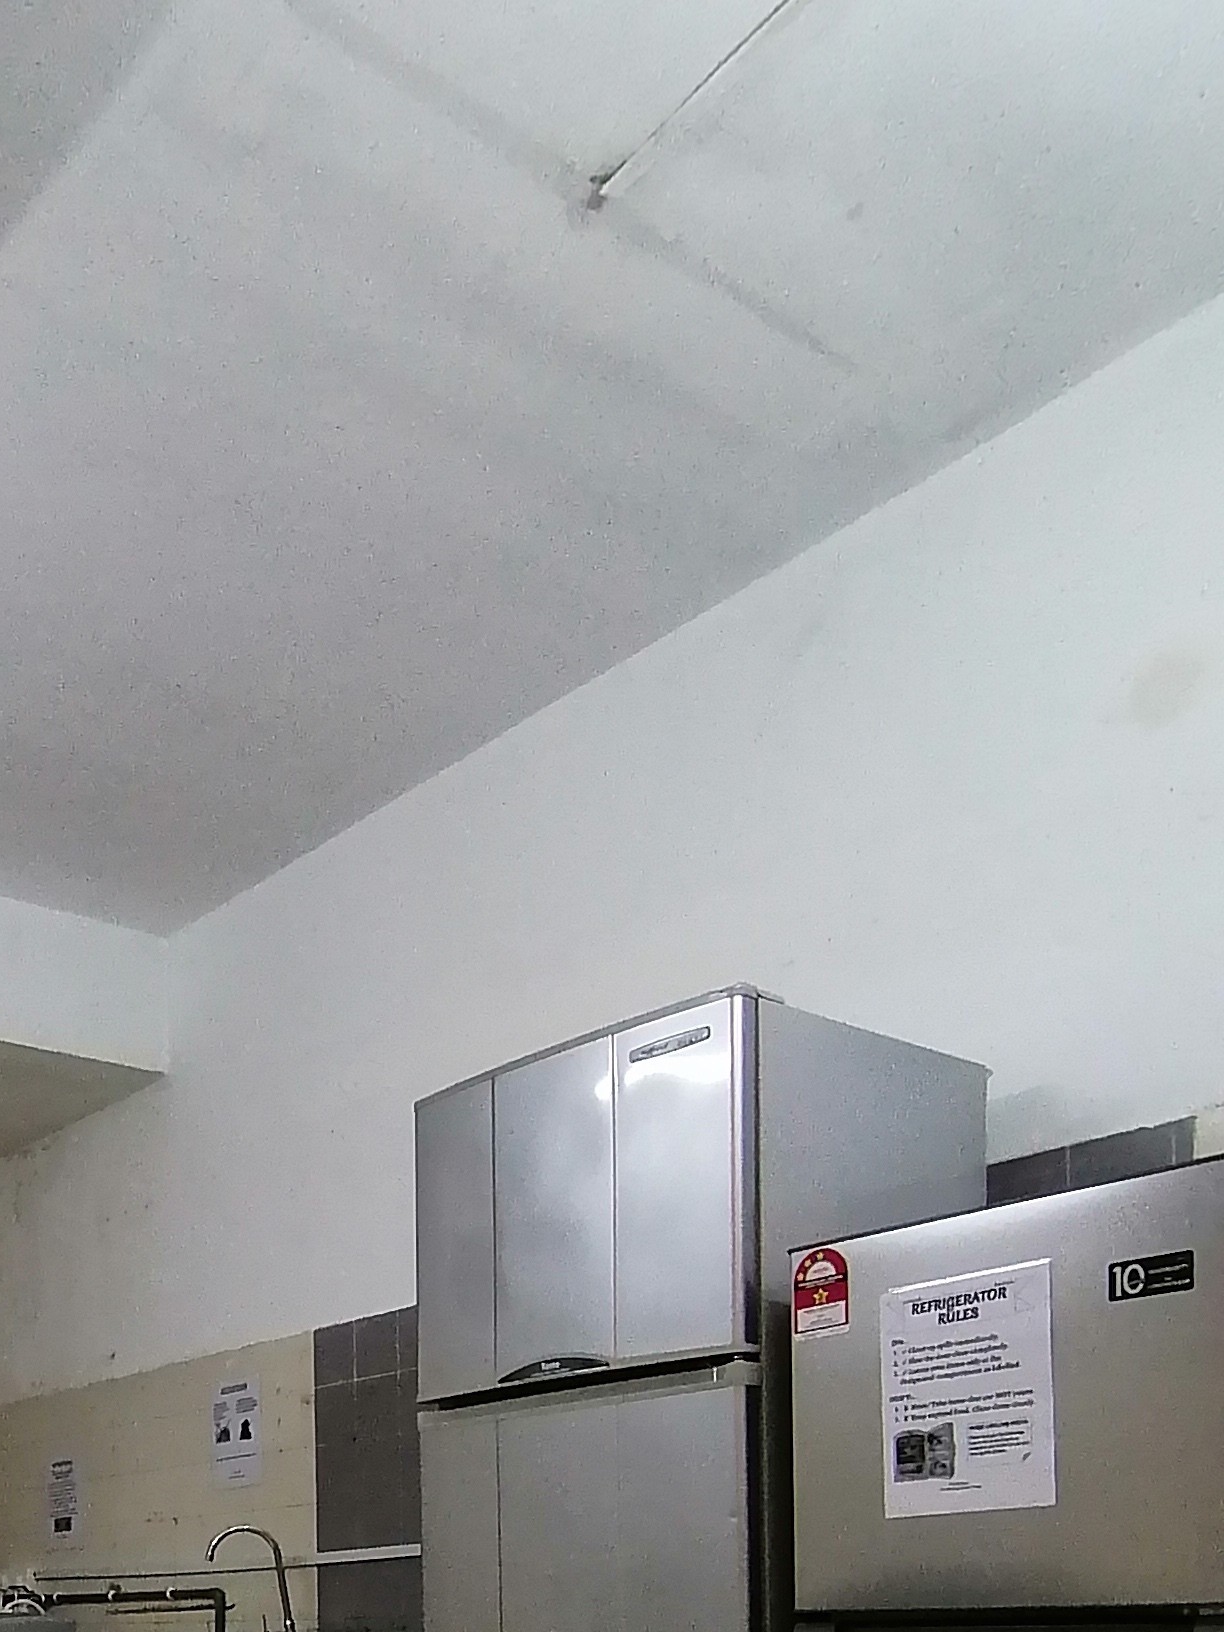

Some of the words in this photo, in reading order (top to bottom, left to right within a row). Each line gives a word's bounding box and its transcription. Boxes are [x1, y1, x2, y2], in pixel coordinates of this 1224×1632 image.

[1112, 1263, 1145, 1297] 10
[911, 1286, 1008, 1316] REFRIGERATOR
[937, 1306, 980, 1326] RULES
